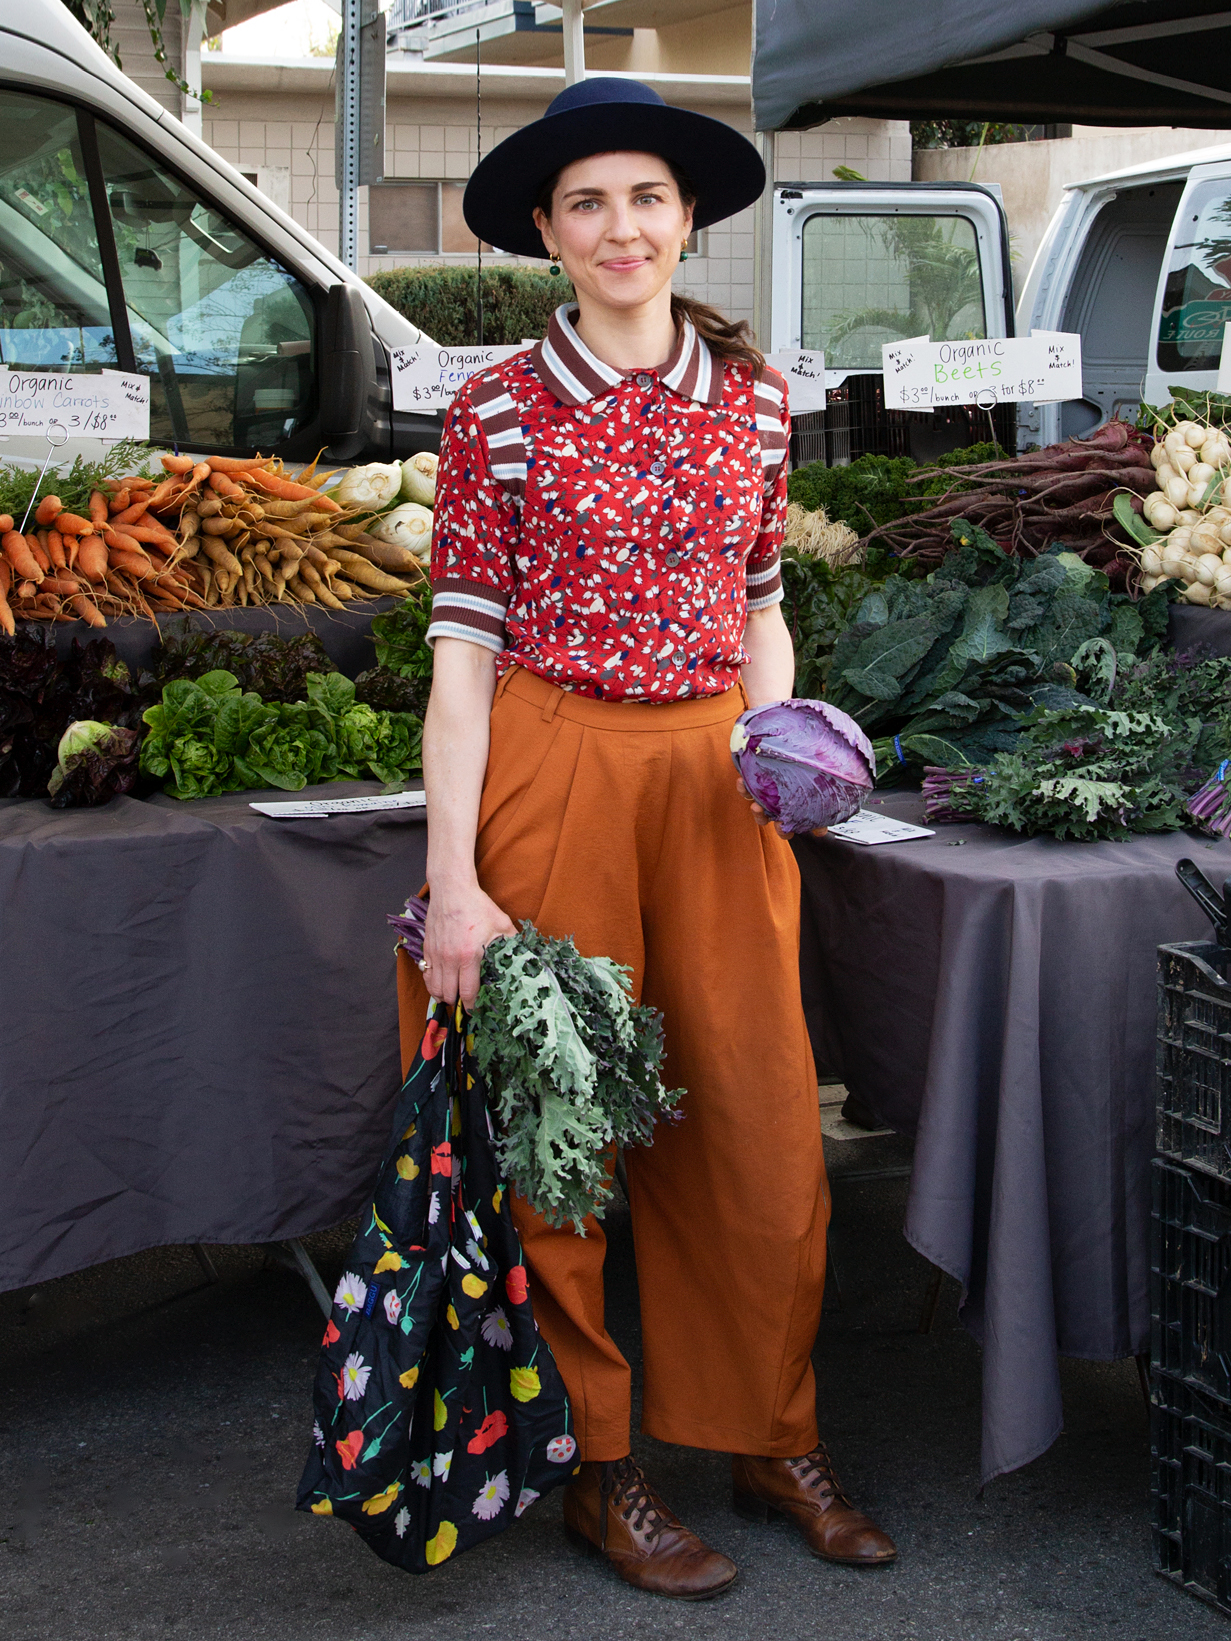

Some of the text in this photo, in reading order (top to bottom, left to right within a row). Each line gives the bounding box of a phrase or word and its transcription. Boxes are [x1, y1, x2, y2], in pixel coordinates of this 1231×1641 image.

[393, 350, 405, 359] Mix
[888, 350, 902, 360] Mix
[938, 341, 1005, 366] Organic
[1048, 345, 1064, 354] Mix
[438, 350, 494, 370] Organic
[798, 355, 814, 364] Mix
[1048, 359, 1075, 369] Match!
[439, 369, 475, 383] Fenn
[934, 362, 1002, 384] Beets
[9, 374, 74, 398] Organic
[121, 381, 135, 390] Mix
[1001, 384, 1015, 396] for
[0, 391, 110, 410] inbow Carrots
